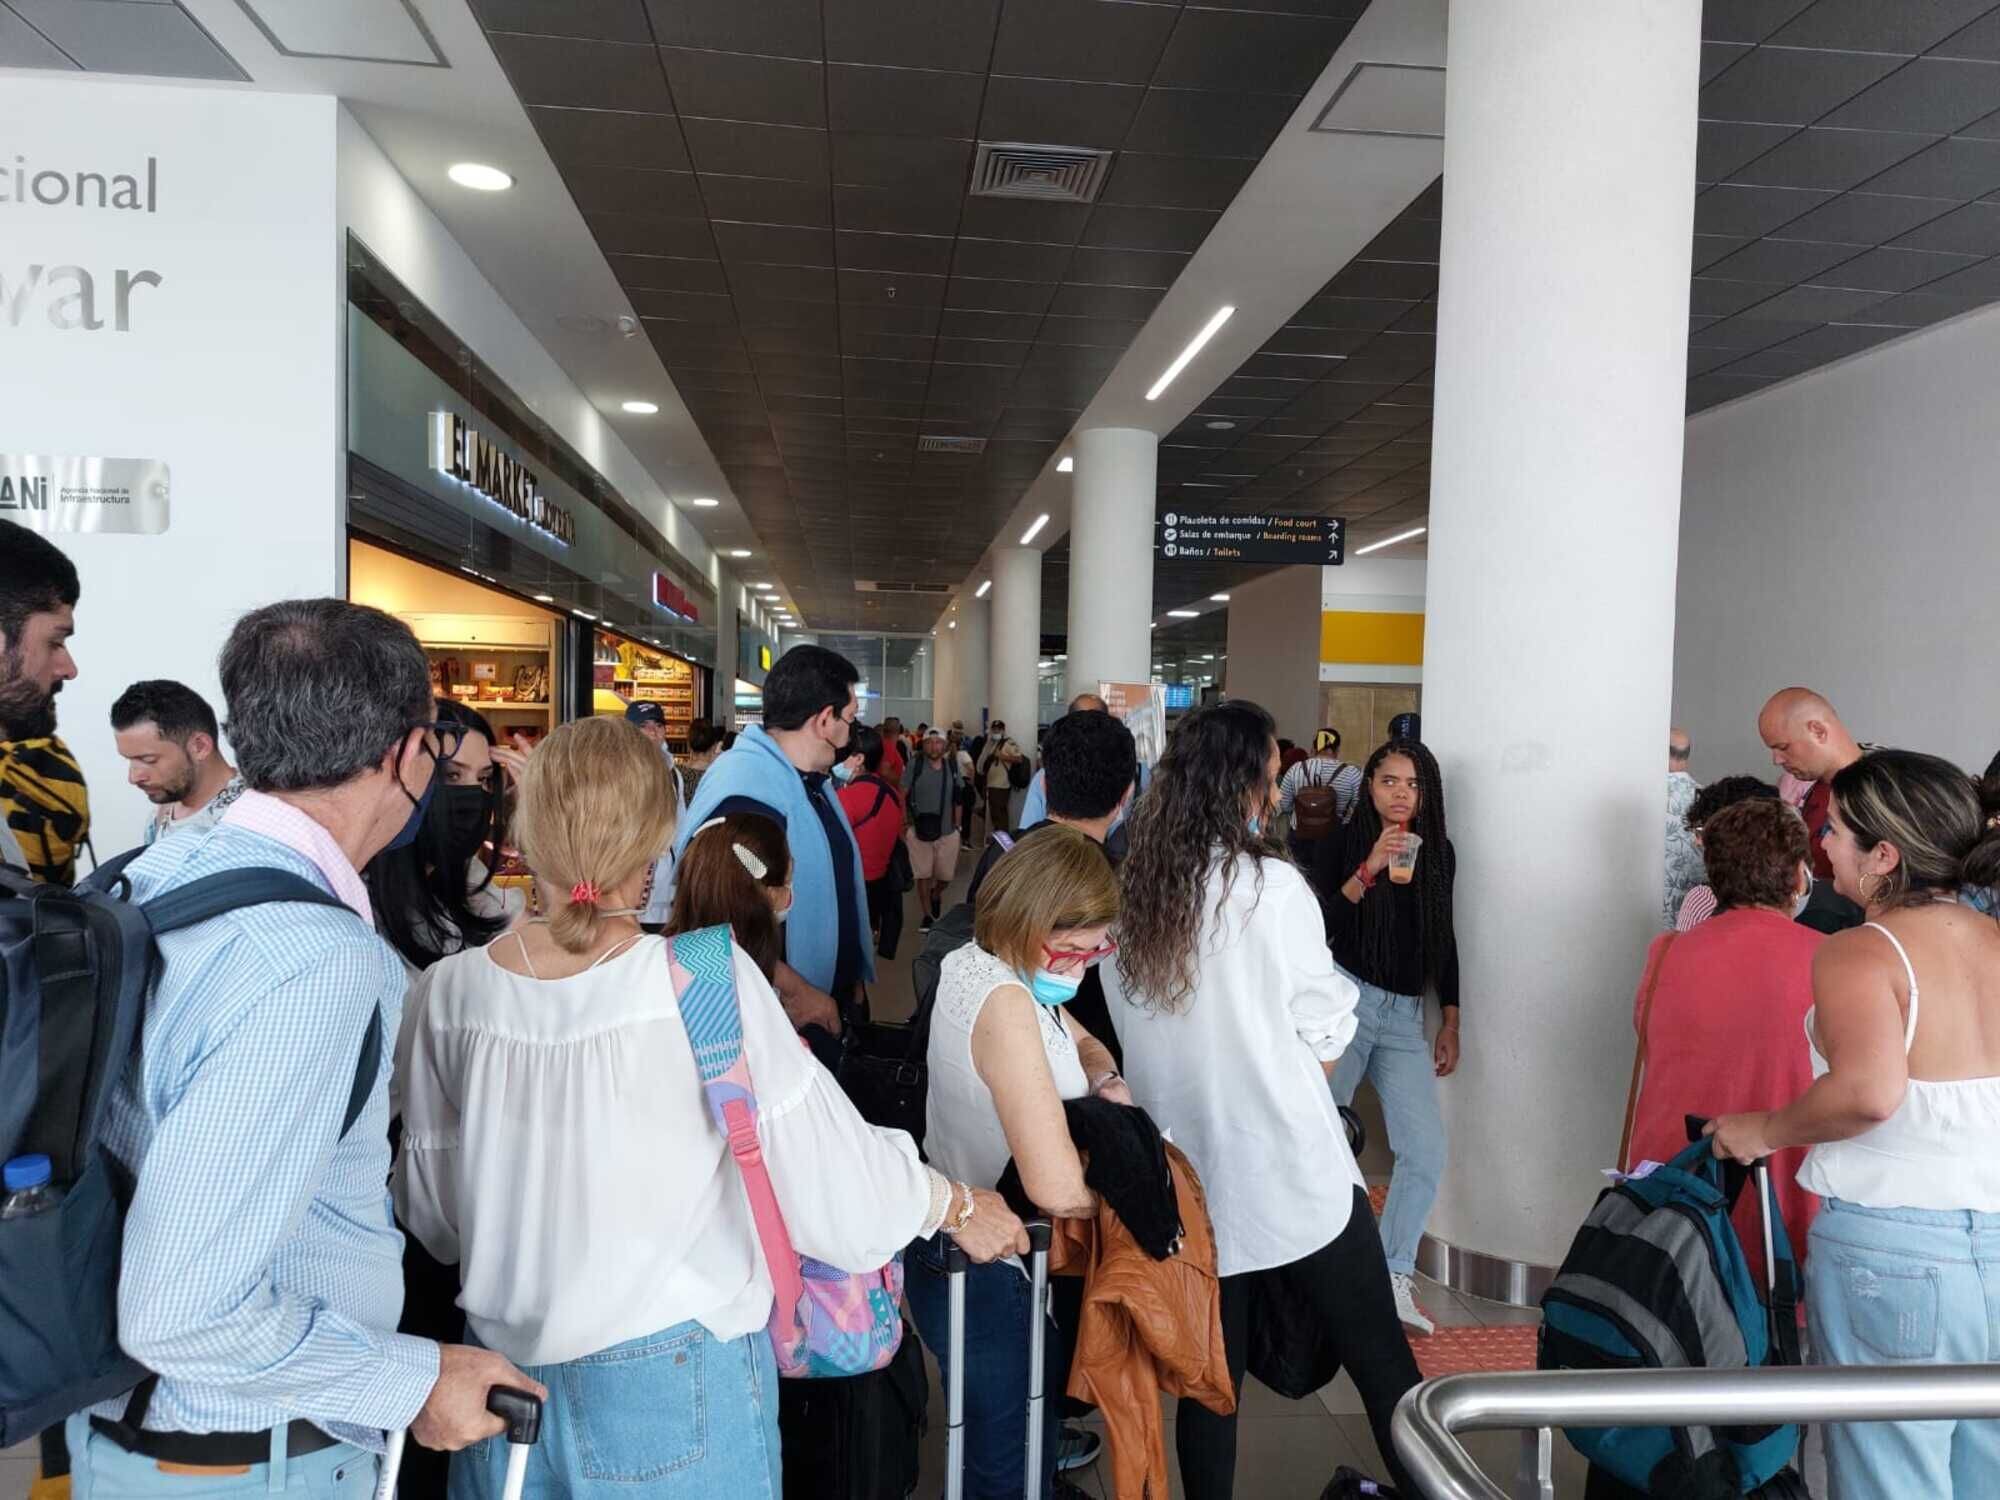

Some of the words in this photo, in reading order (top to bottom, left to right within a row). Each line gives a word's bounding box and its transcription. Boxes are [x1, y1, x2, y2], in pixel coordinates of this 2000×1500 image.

[0, 155, 157, 213] ional
[470, 431, 537, 522] MARKET
[60, 495, 130, 504] Infraestructura
[1179, 515, 1216, 525] Plazoleta
[1220, 515, 1229, 525] de
[1232, 515, 1266, 525] comidas
[1274, 517, 1293, 527] Food
[1296, 518, 1317, 528] court
[1179, 529, 1199, 539] Salas
[1202, 530, 1211, 539] de
[1214, 531, 1251, 541] embarque
[1263, 531, 1296, 543] Boarding
[1298, 534, 1322, 542] rooms
[1180, 546, 1203, 555] Baños
[1214, 547, 1240, 557] Toilets
